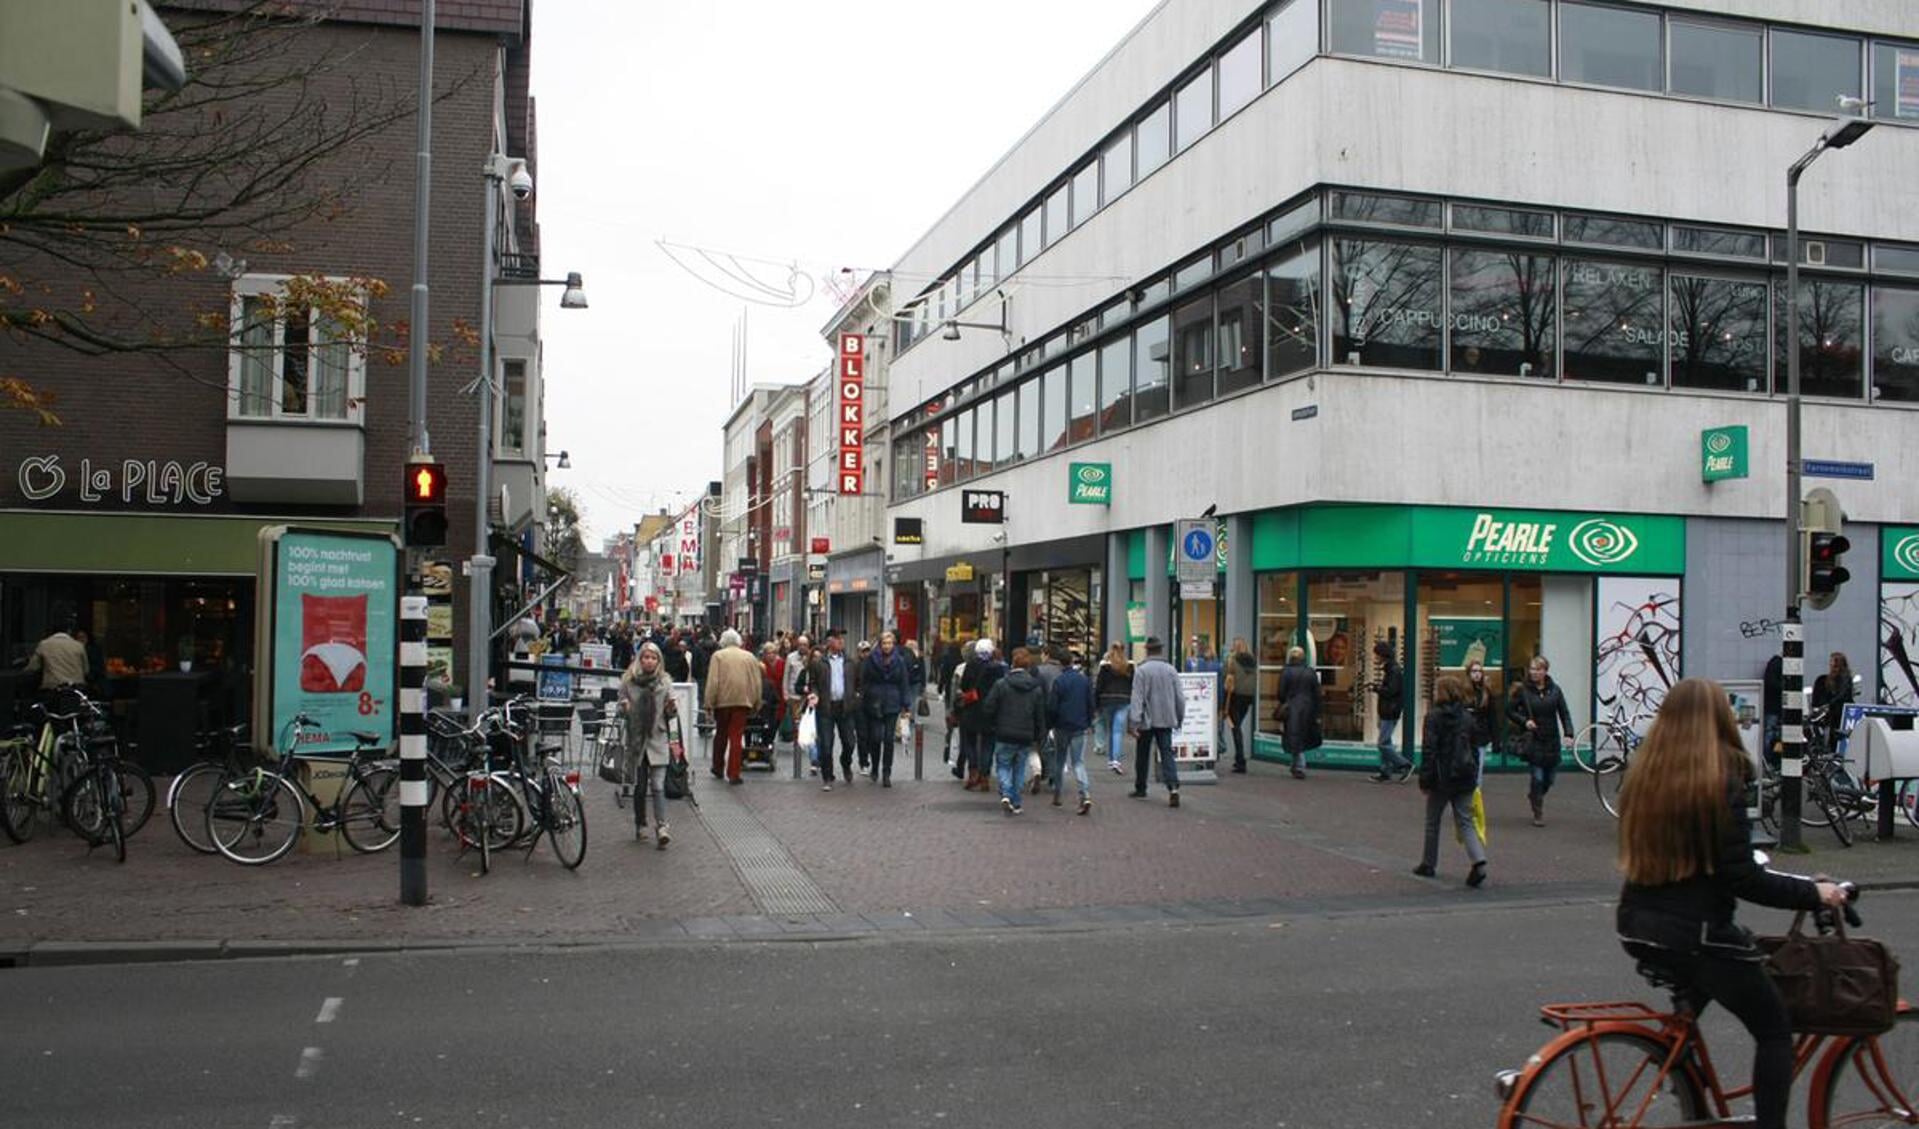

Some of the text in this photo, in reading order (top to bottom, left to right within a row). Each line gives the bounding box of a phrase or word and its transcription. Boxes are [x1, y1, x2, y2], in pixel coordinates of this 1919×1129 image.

[1572, 265, 1650, 289] RELAXEN
[1382, 308, 1500, 333] CAPPUCCINO
[1625, 327, 1690, 348] SALADE
[843, 336, 861, 493] BLOKKER
[79, 458, 224, 504] La PLACE
[1466, 513, 1557, 553] PEARLE
[288, 546, 372, 562] 100% nachtrust
[1462, 551, 1548, 565] OPTICIENS
[288, 561, 349, 575] begint met
[288, 573, 317, 587] 100%
